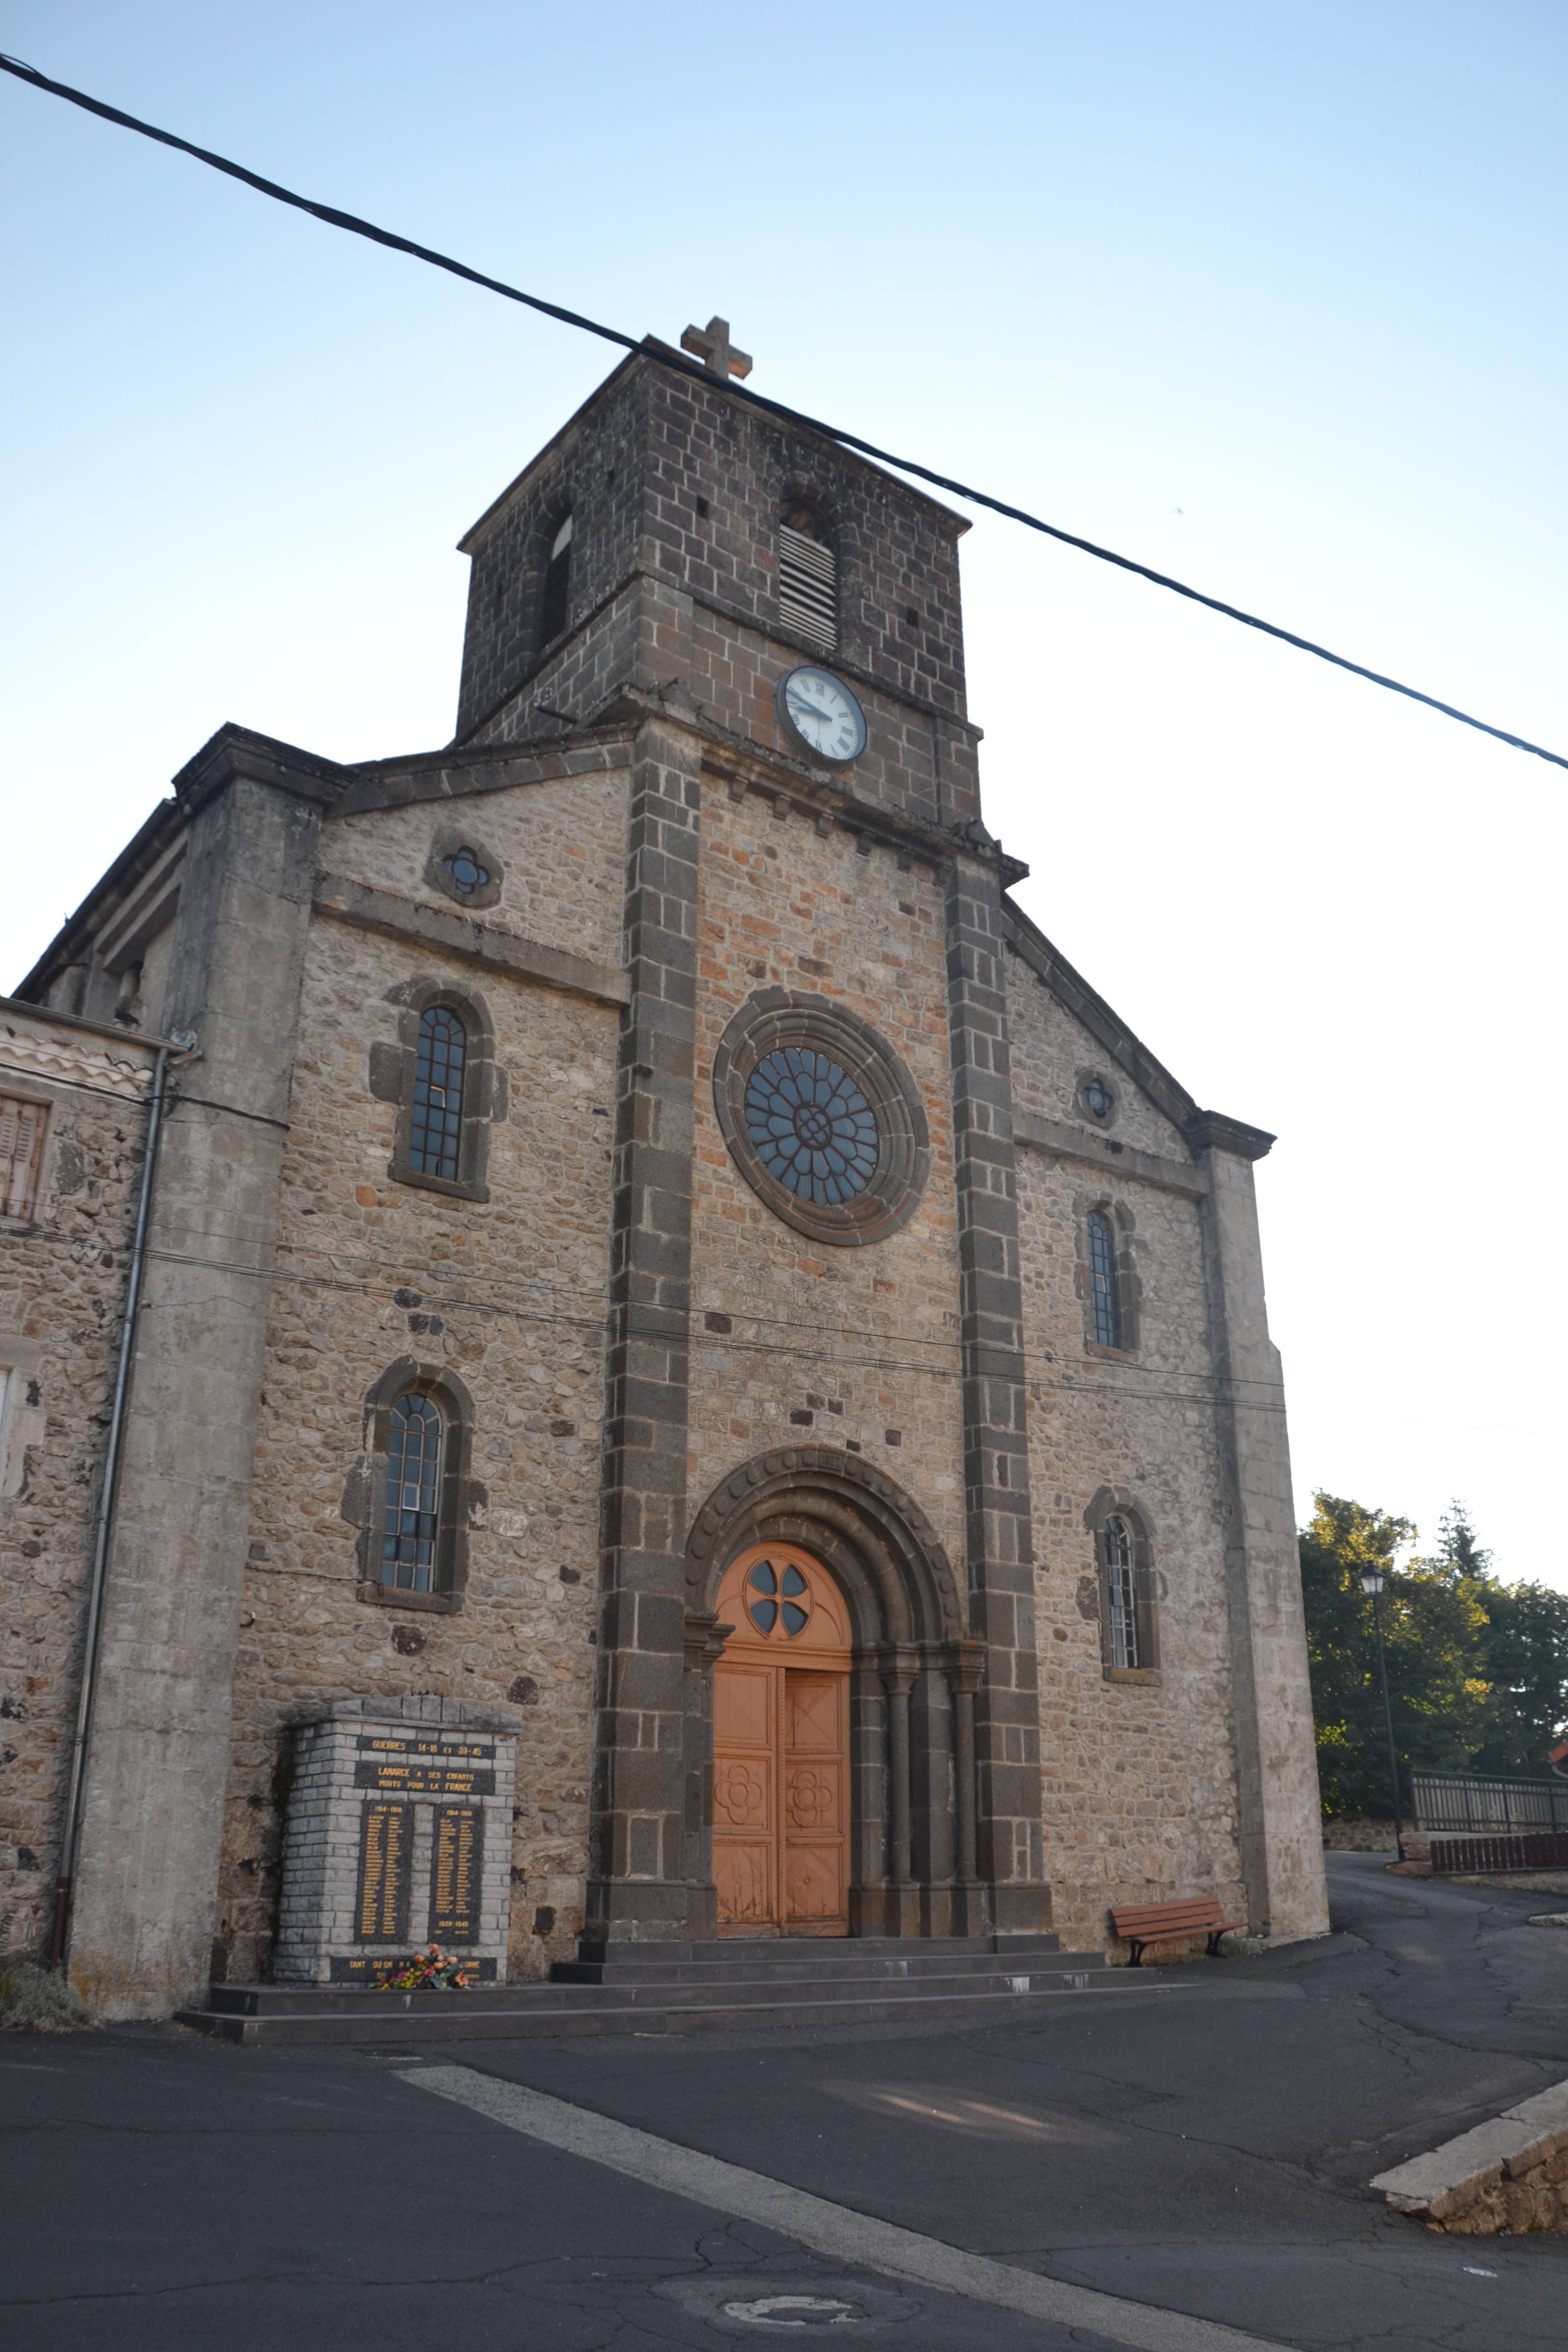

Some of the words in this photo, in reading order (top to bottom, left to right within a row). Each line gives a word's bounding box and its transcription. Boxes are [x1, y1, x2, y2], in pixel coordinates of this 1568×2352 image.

[372, 1740, 406, 1751] GUERRES
[458, 1746, 481, 1756] 39-45
[378, 1767, 410, 1777] LANARCE
[446, 1773, 474, 1781] ENFANTS
[378, 1780, 401, 1788] MORTS
[445, 1782, 472, 1792] FRANCE
[350, 1961, 365, 1969] TANT
